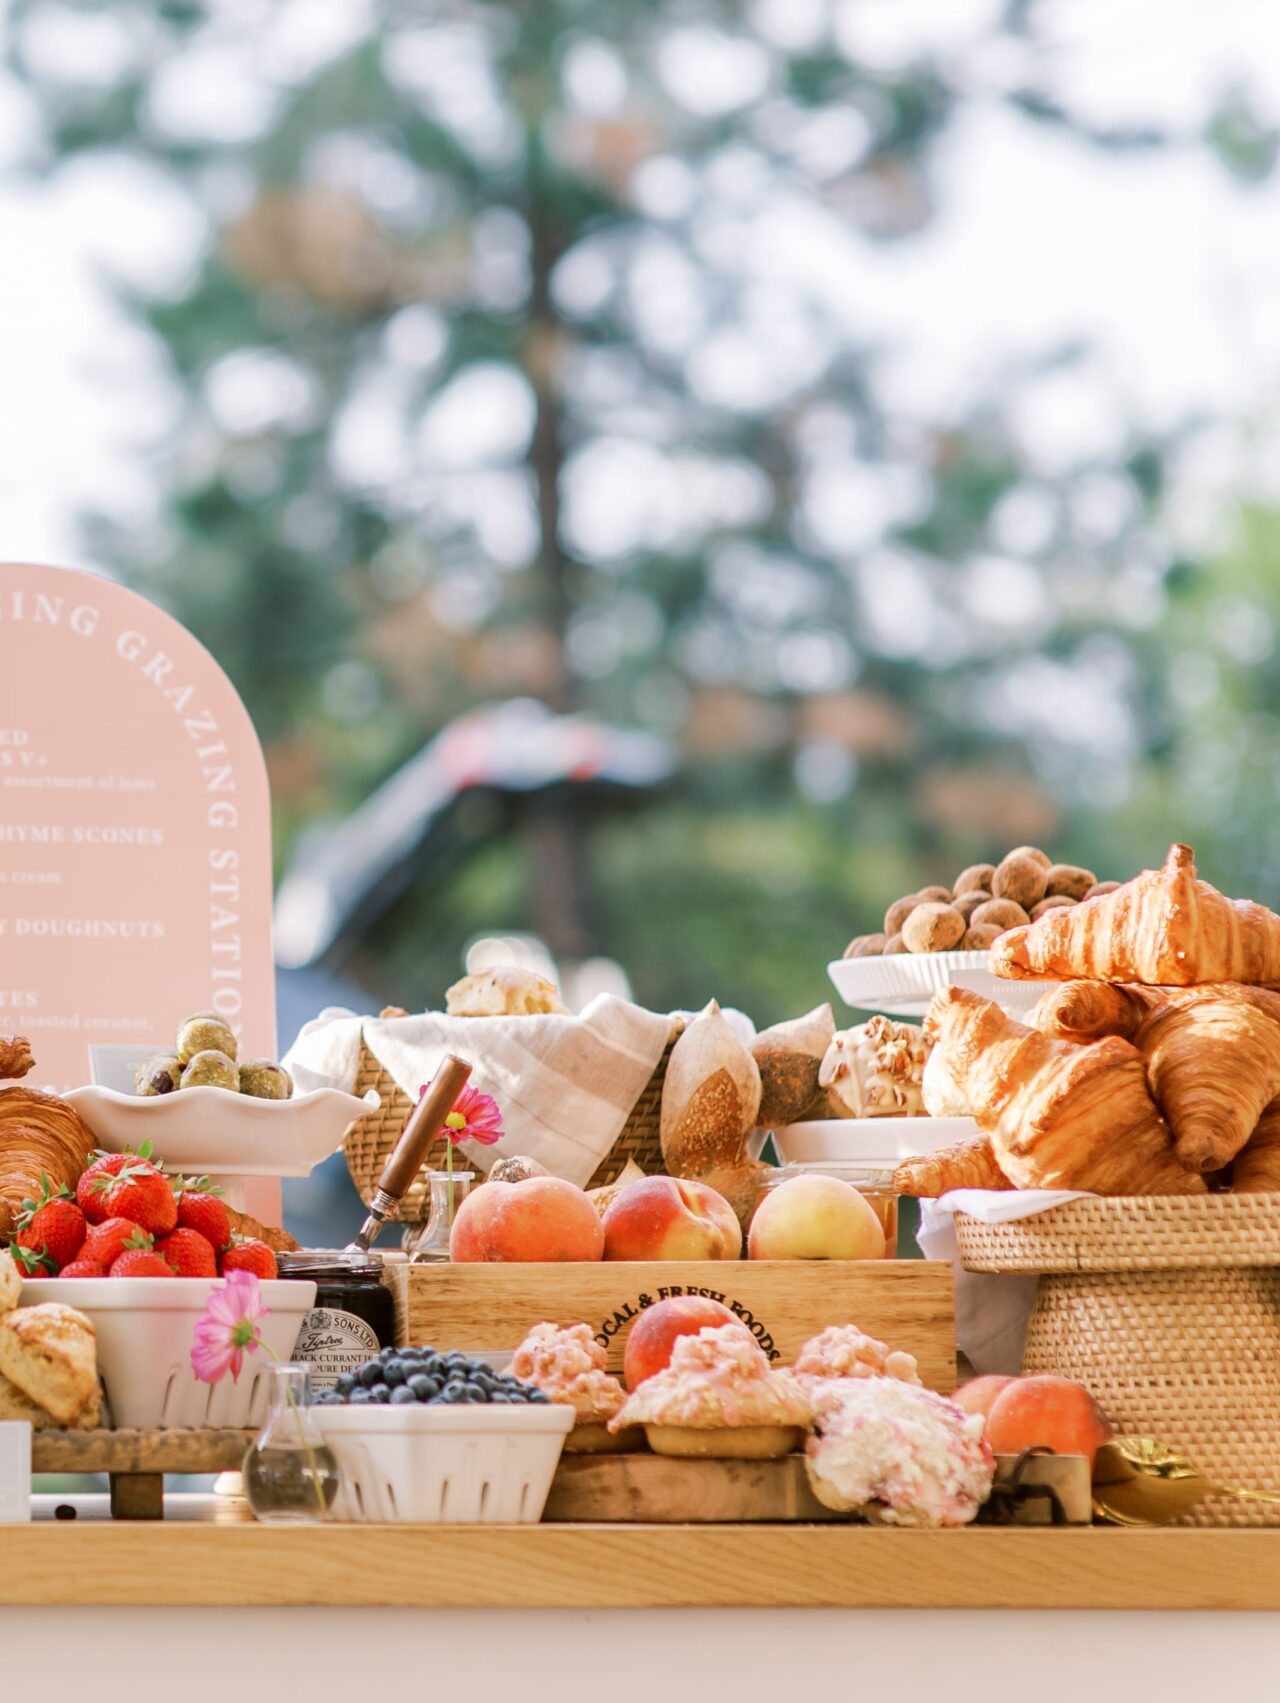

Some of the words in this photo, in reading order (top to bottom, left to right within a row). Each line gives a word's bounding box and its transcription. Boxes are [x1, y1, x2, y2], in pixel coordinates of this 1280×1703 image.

[115, 629, 239, 829] GRAZING
[3, 773, 94, 789] assortment
[72, 826, 164, 846] SCONES
[11, 870, 62, 885] cream
[14, 917, 166, 938] DOUGHNUTS
[20, 1013, 79, 1029] toasted
[334, 1317, 360, 1335] SONS
[359, 1330, 374, 1348] LTD
[593, 1303, 638, 1349] OCAL
[638, 1293, 655, 1310] &
[657, 1286, 726, 1304] FRESH
[729, 1300, 782, 1362] FOODS
[290, 1354, 317, 1362] BLACK
[320, 1354, 362, 1363] CURRANT
